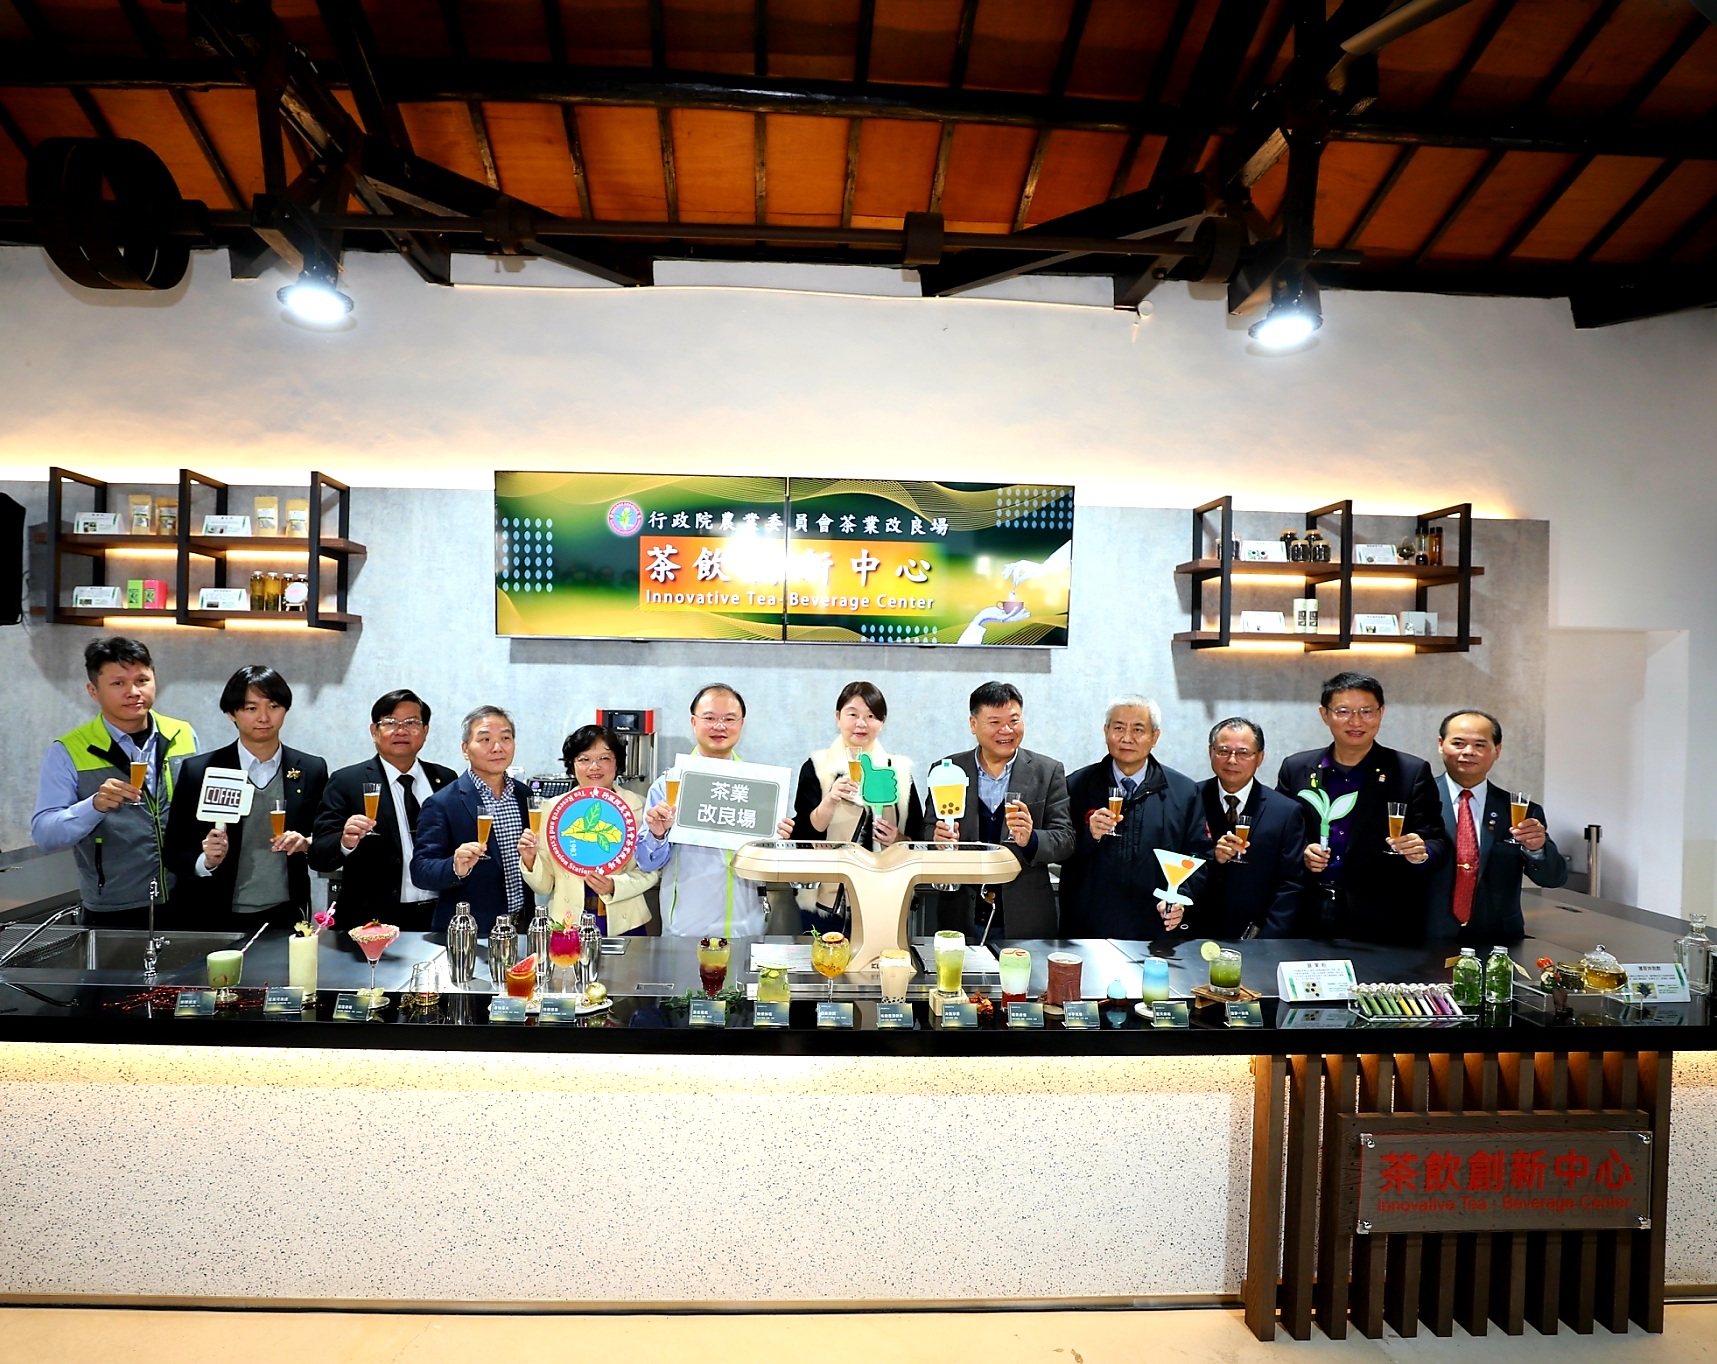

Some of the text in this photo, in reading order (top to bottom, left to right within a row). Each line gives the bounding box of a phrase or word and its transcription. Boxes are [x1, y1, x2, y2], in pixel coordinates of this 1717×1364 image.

[648, 510, 949, 537] 行政院農業委員會茶業改良場
[646, 590, 740, 605] Innovative
[876, 593, 935, 609] Center
[205, 787, 241, 806] COFFEE
[573, 790, 587, 799] Tea
[710, 781, 750, 803] 茶業
[697, 803, 757, 829] 改良場
[1379, 1148, 1633, 1193] 茶飲創新中心
[1377, 1198, 1456, 1213] Innovative
[1461, 1195, 1488, 1211] Tea
[1502, 1194, 1576, 1213] Beverage
[1580, 1194, 1633, 1210] Center
